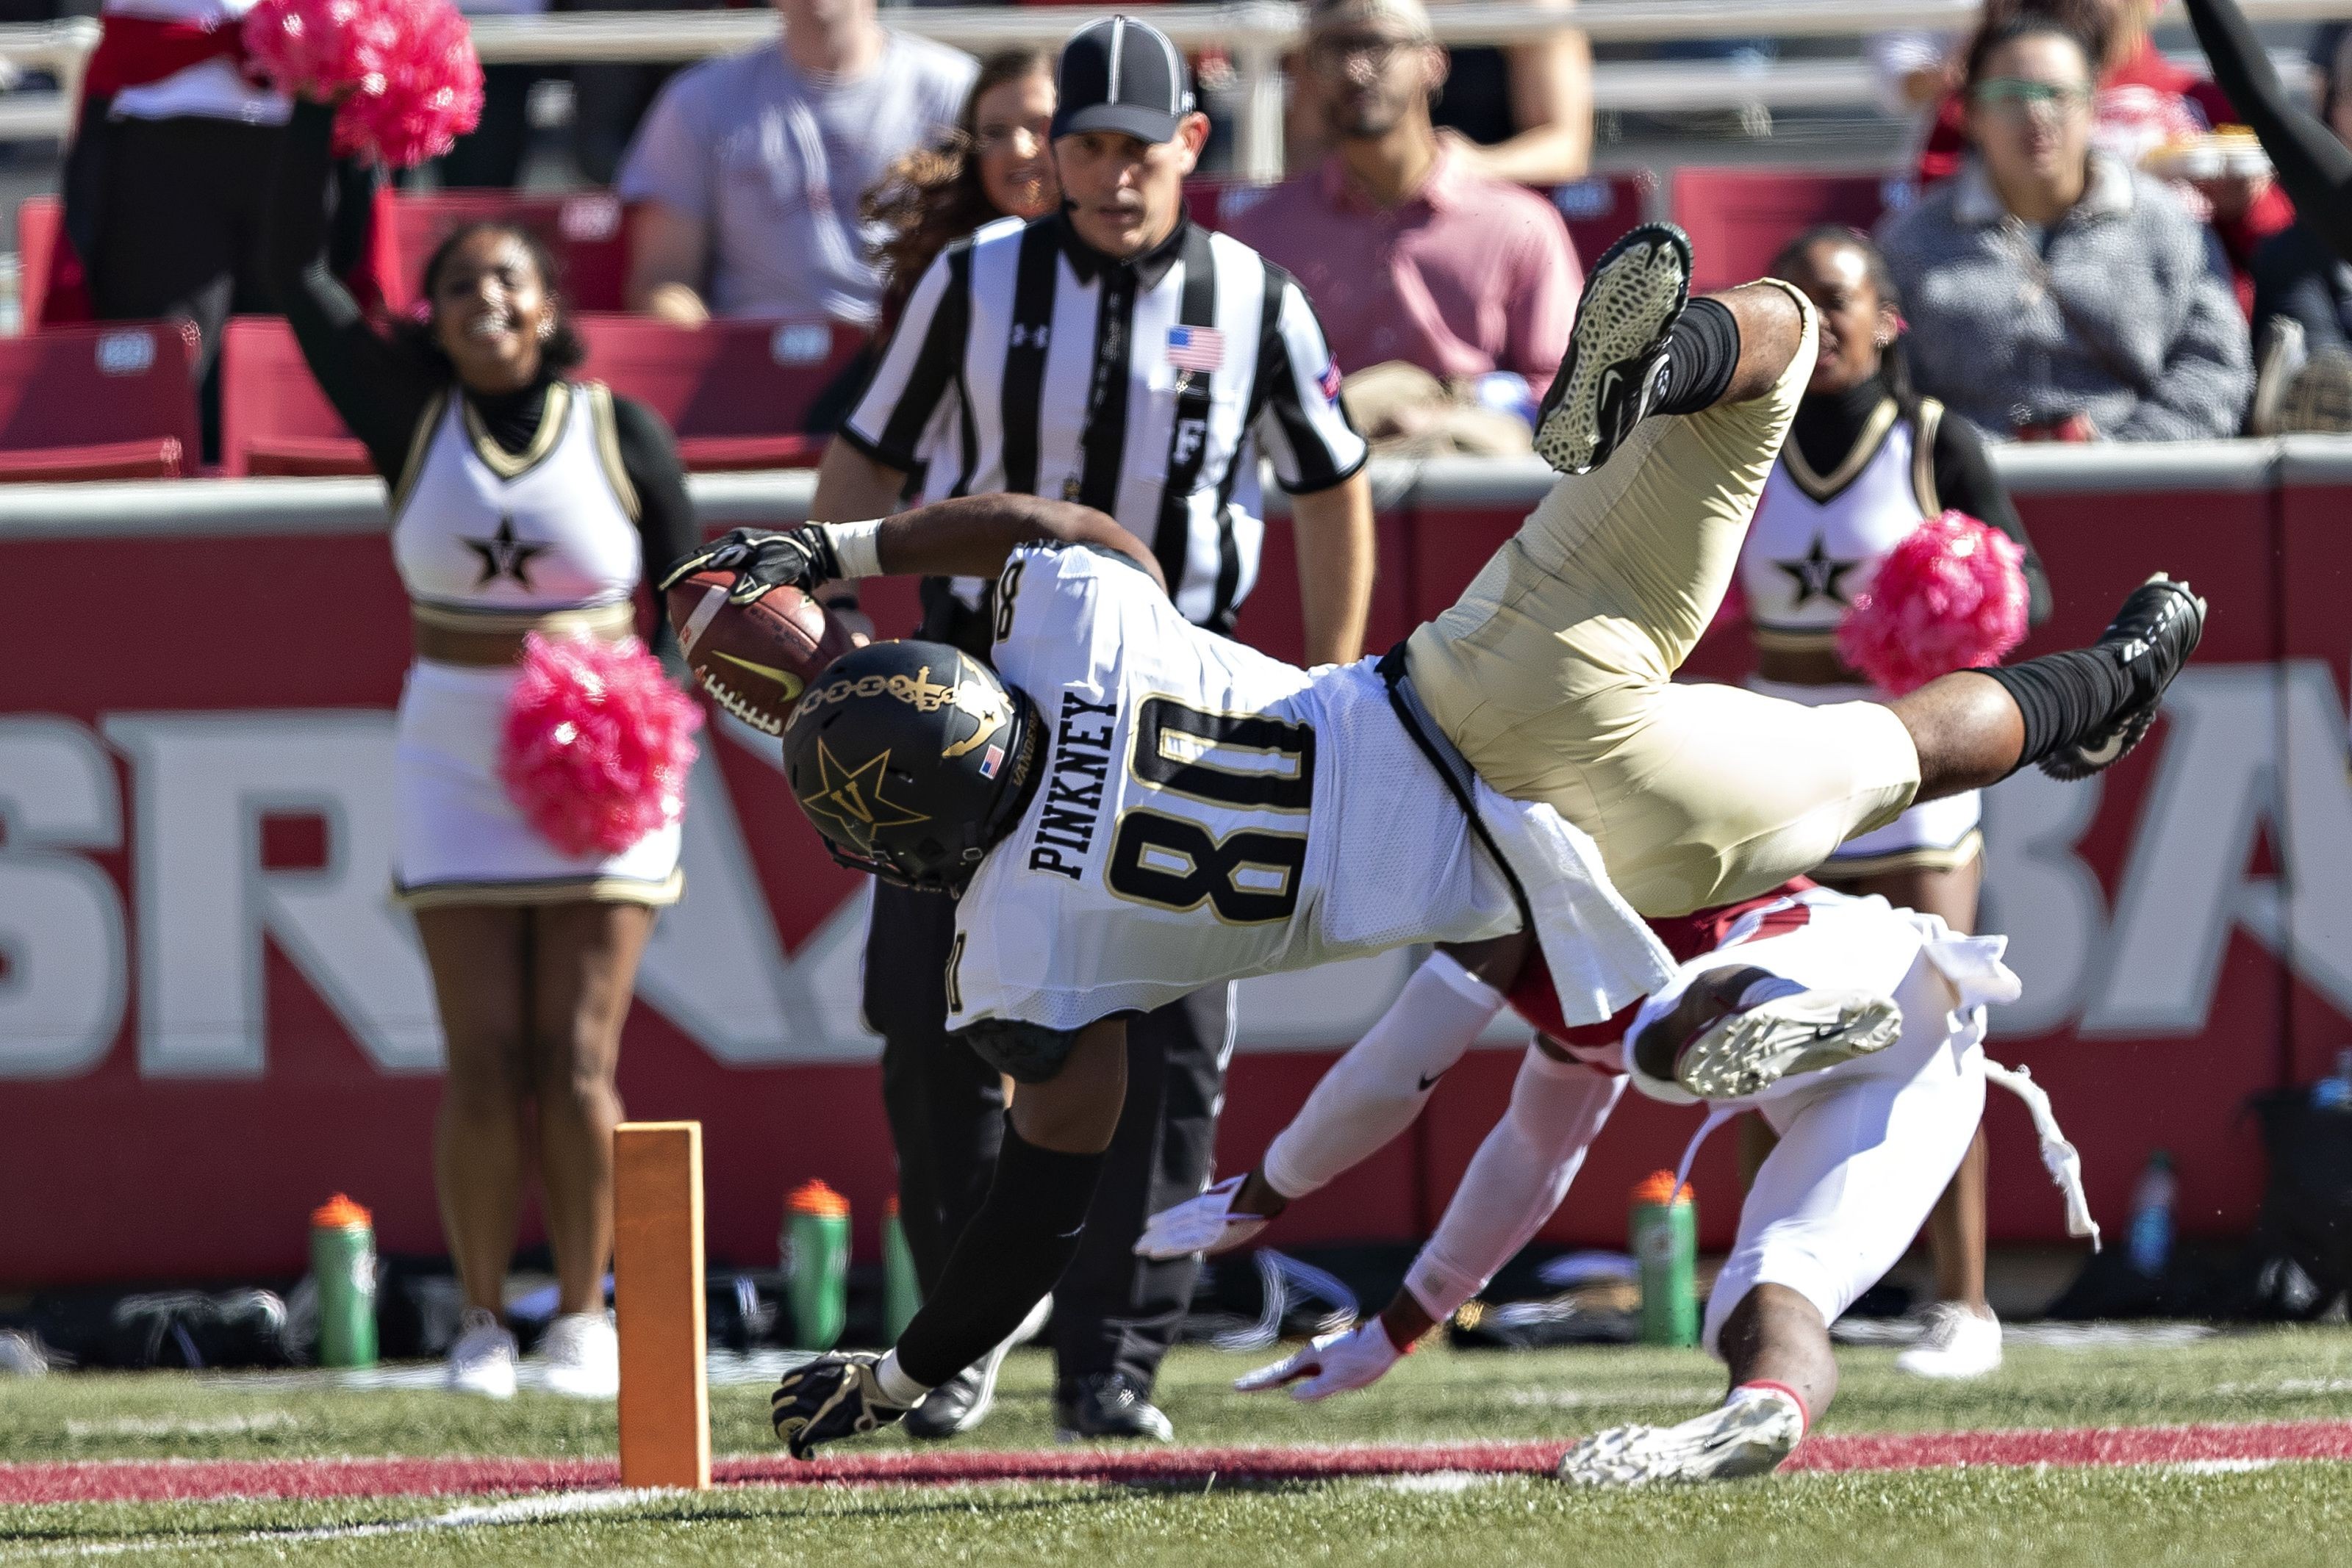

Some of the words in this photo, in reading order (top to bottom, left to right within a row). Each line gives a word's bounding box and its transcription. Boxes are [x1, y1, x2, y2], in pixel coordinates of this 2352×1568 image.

[831, 781, 874, 823] V
[1028, 691, 1117, 881] PINKNEY
[1104, 690, 1318, 927] 80
